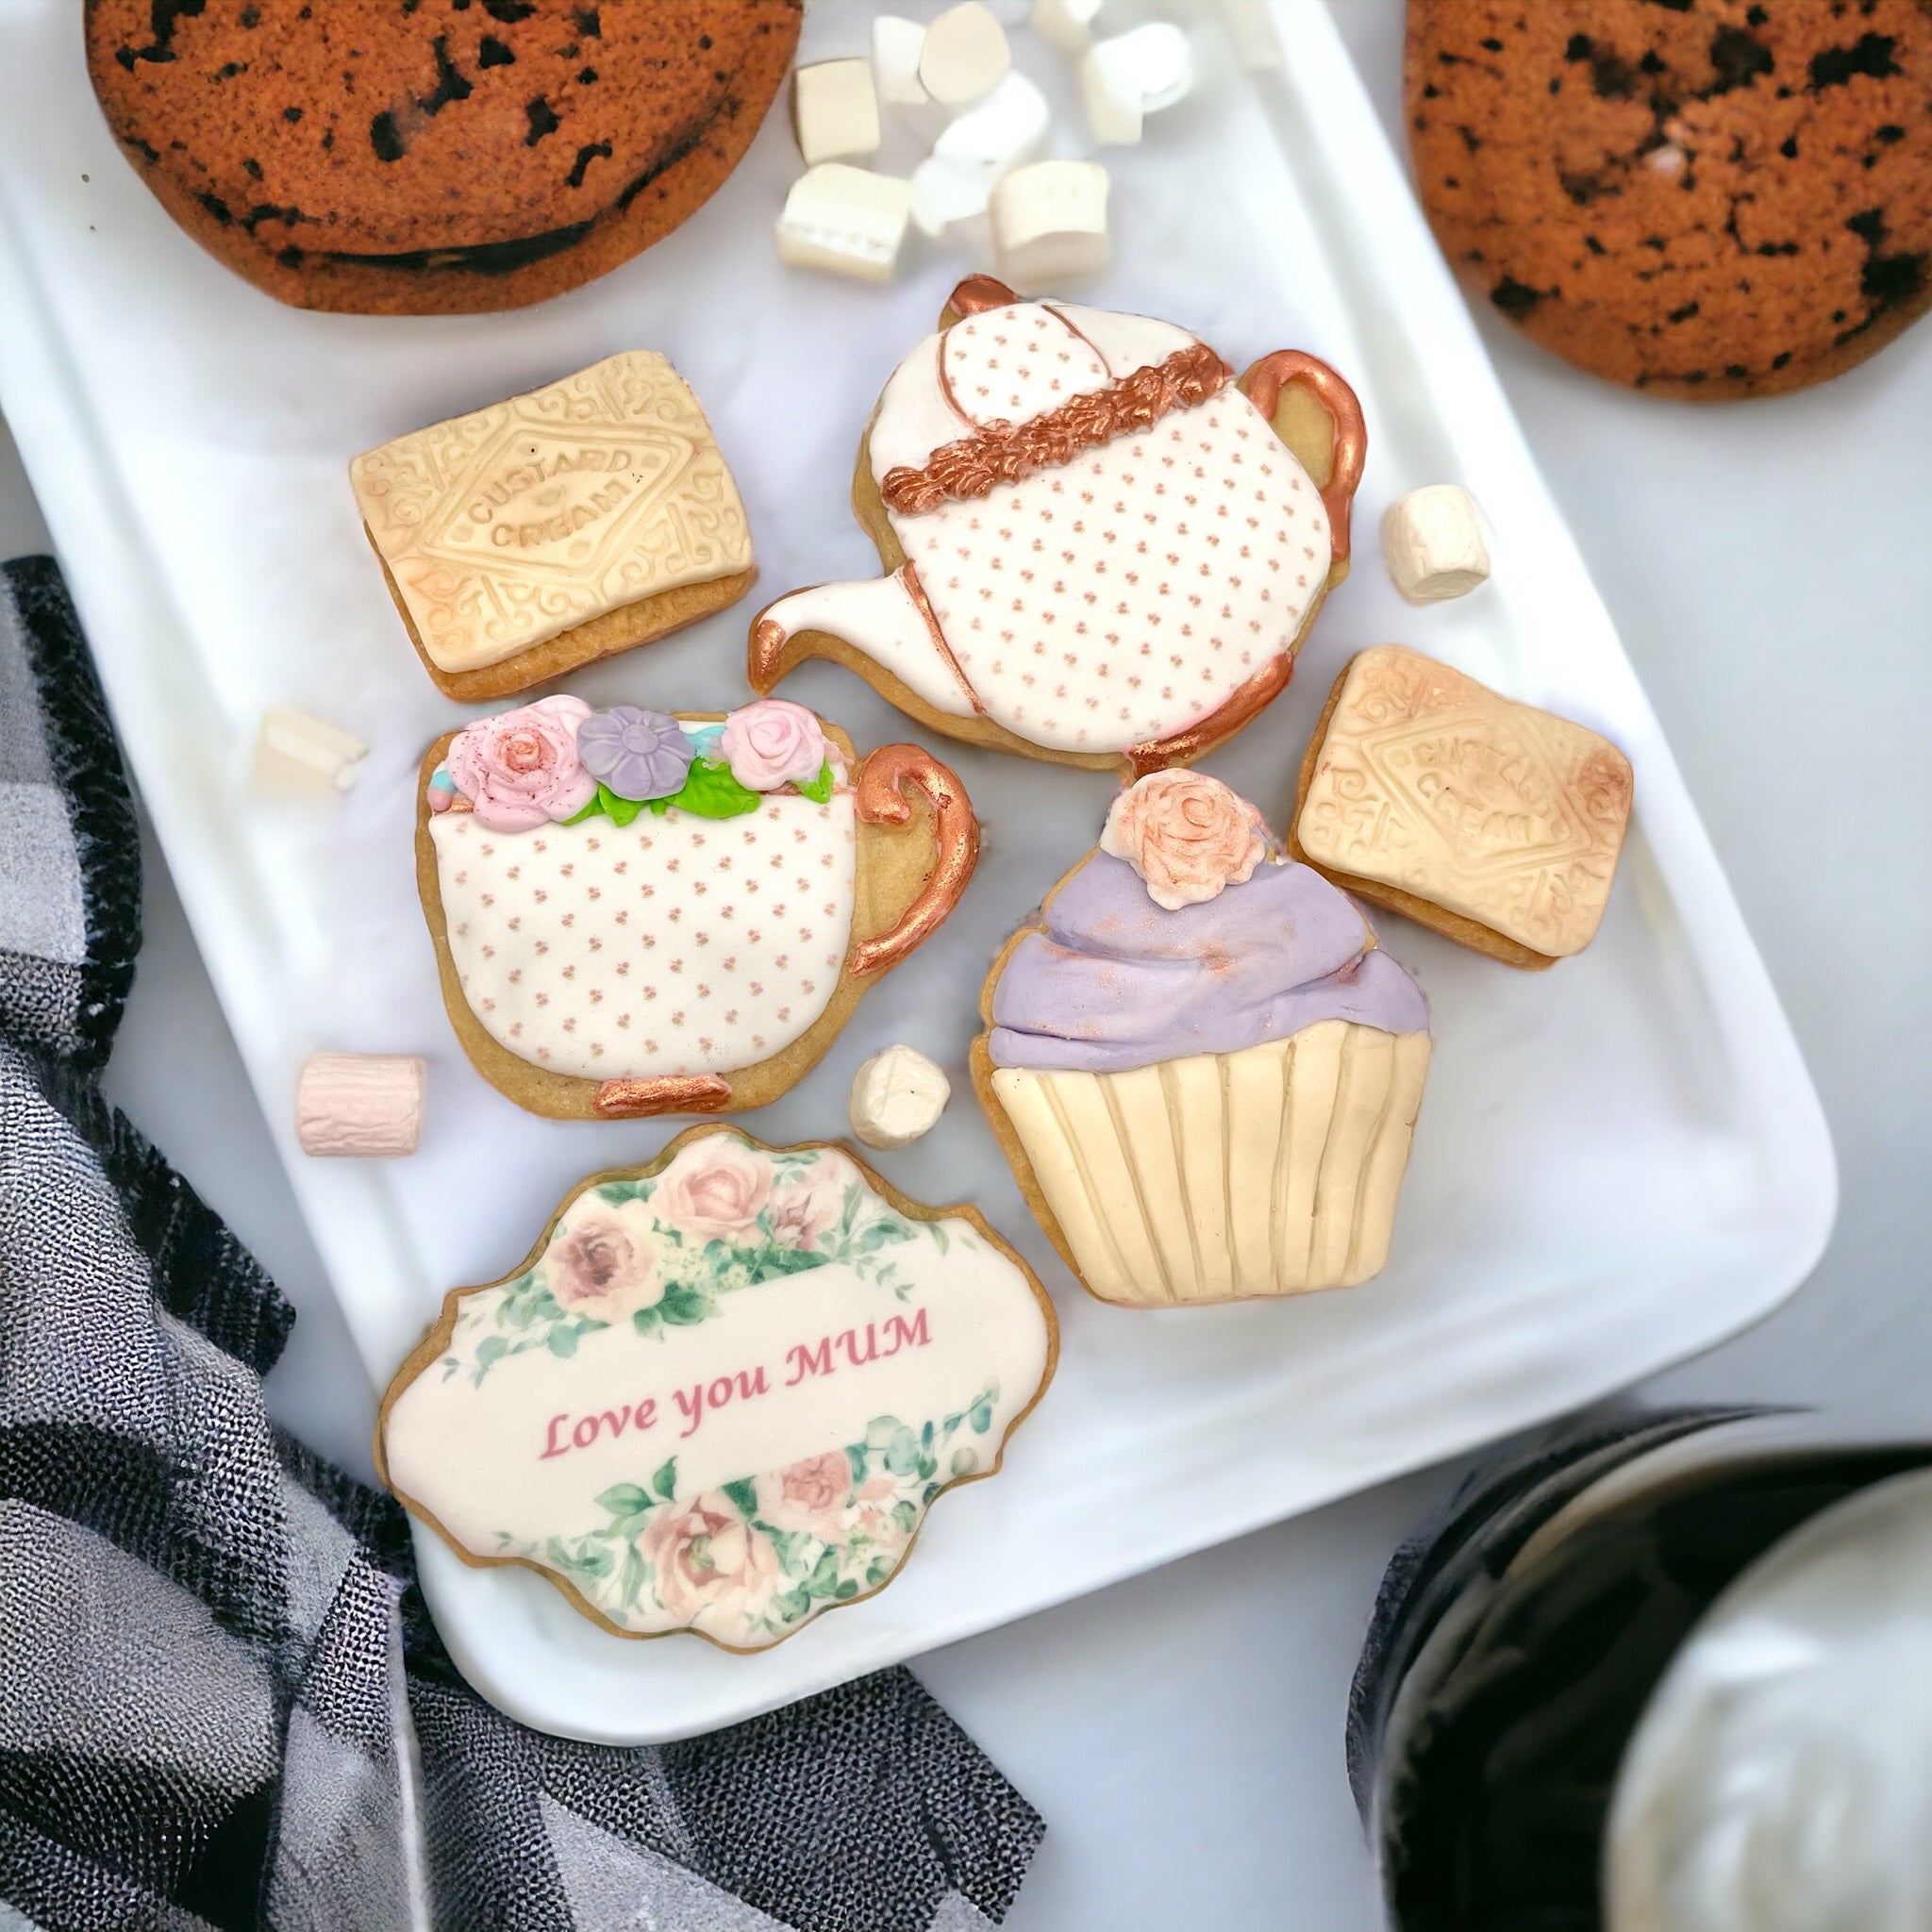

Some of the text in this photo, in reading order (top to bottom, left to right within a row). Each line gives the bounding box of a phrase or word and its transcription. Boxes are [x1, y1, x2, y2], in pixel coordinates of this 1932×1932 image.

[468, 448, 632, 525] CUSTARD
[491, 479, 631, 548] CREAM
[539, 1307, 933, 1460] Love you MUM
